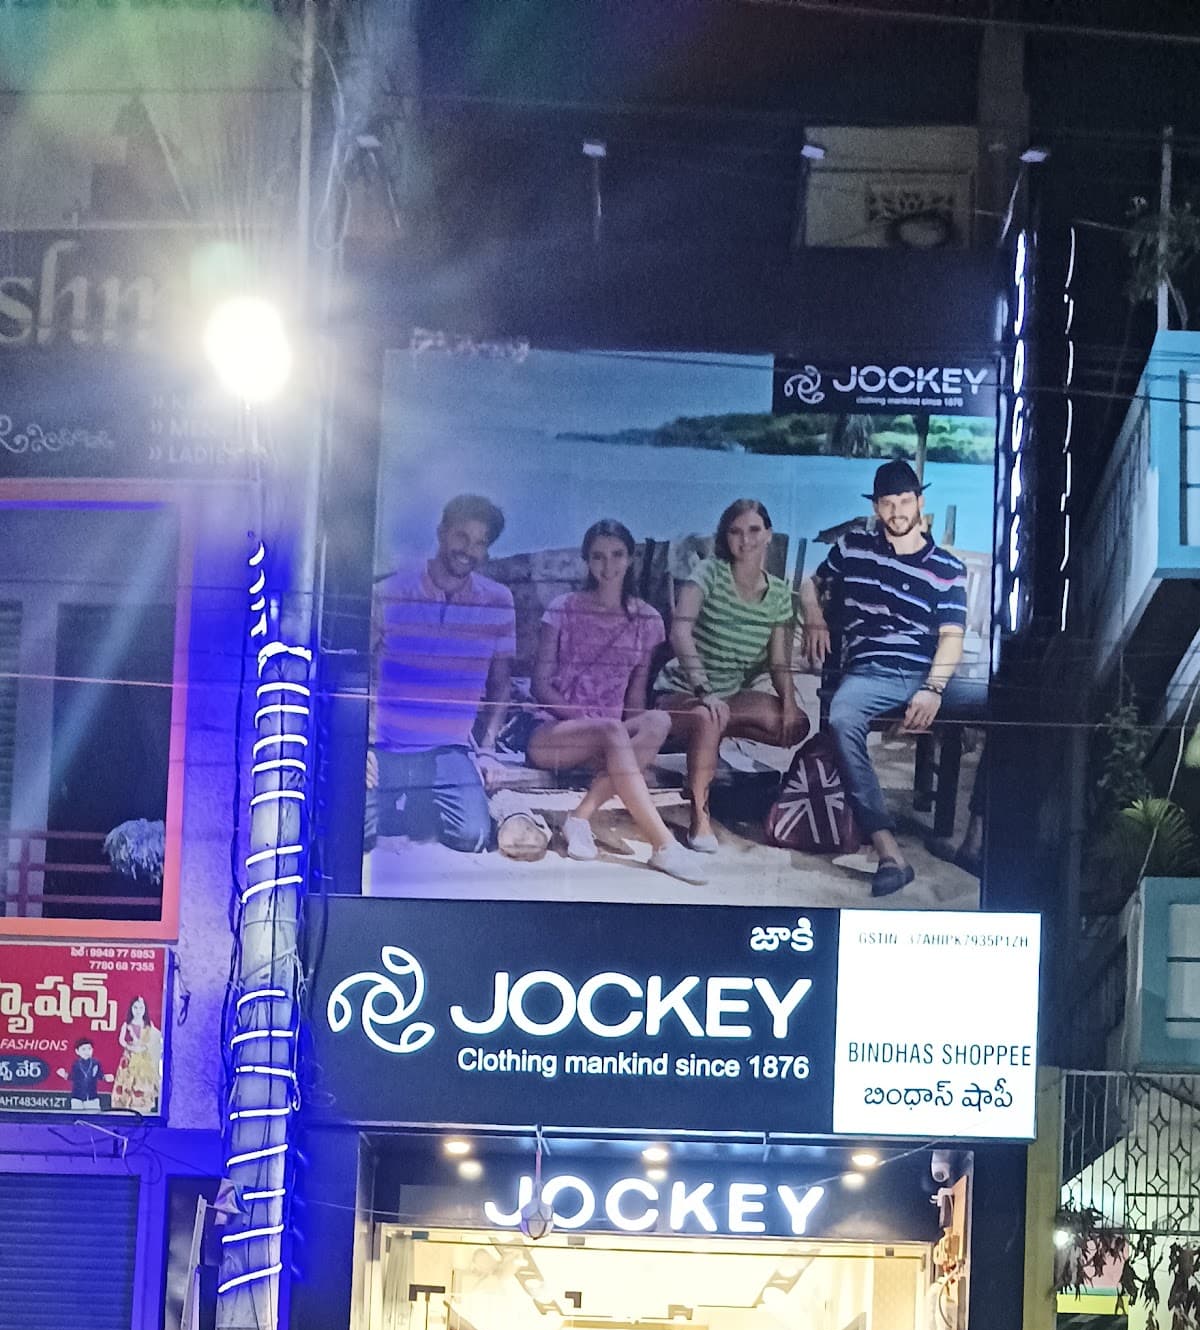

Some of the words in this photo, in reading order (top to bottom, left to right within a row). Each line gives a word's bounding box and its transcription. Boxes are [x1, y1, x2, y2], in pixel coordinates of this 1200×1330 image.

[832, 365, 988, 395] JOCKEY
[450, 970, 812, 1039] JOCKEY
[0, 1038, 69, 1051] FASHIONS
[848, 1041, 934, 1065] BINDHAS
[941, 1043, 1032, 1066] SHOPPEE
[457, 1047, 559, 1079] Clothing
[565, 1052, 668, 1076] mankind
[675, 1055, 741, 1077] since
[749, 1055, 811, 1079] 1876
[484, 1175, 825, 1235] JOCKEY
